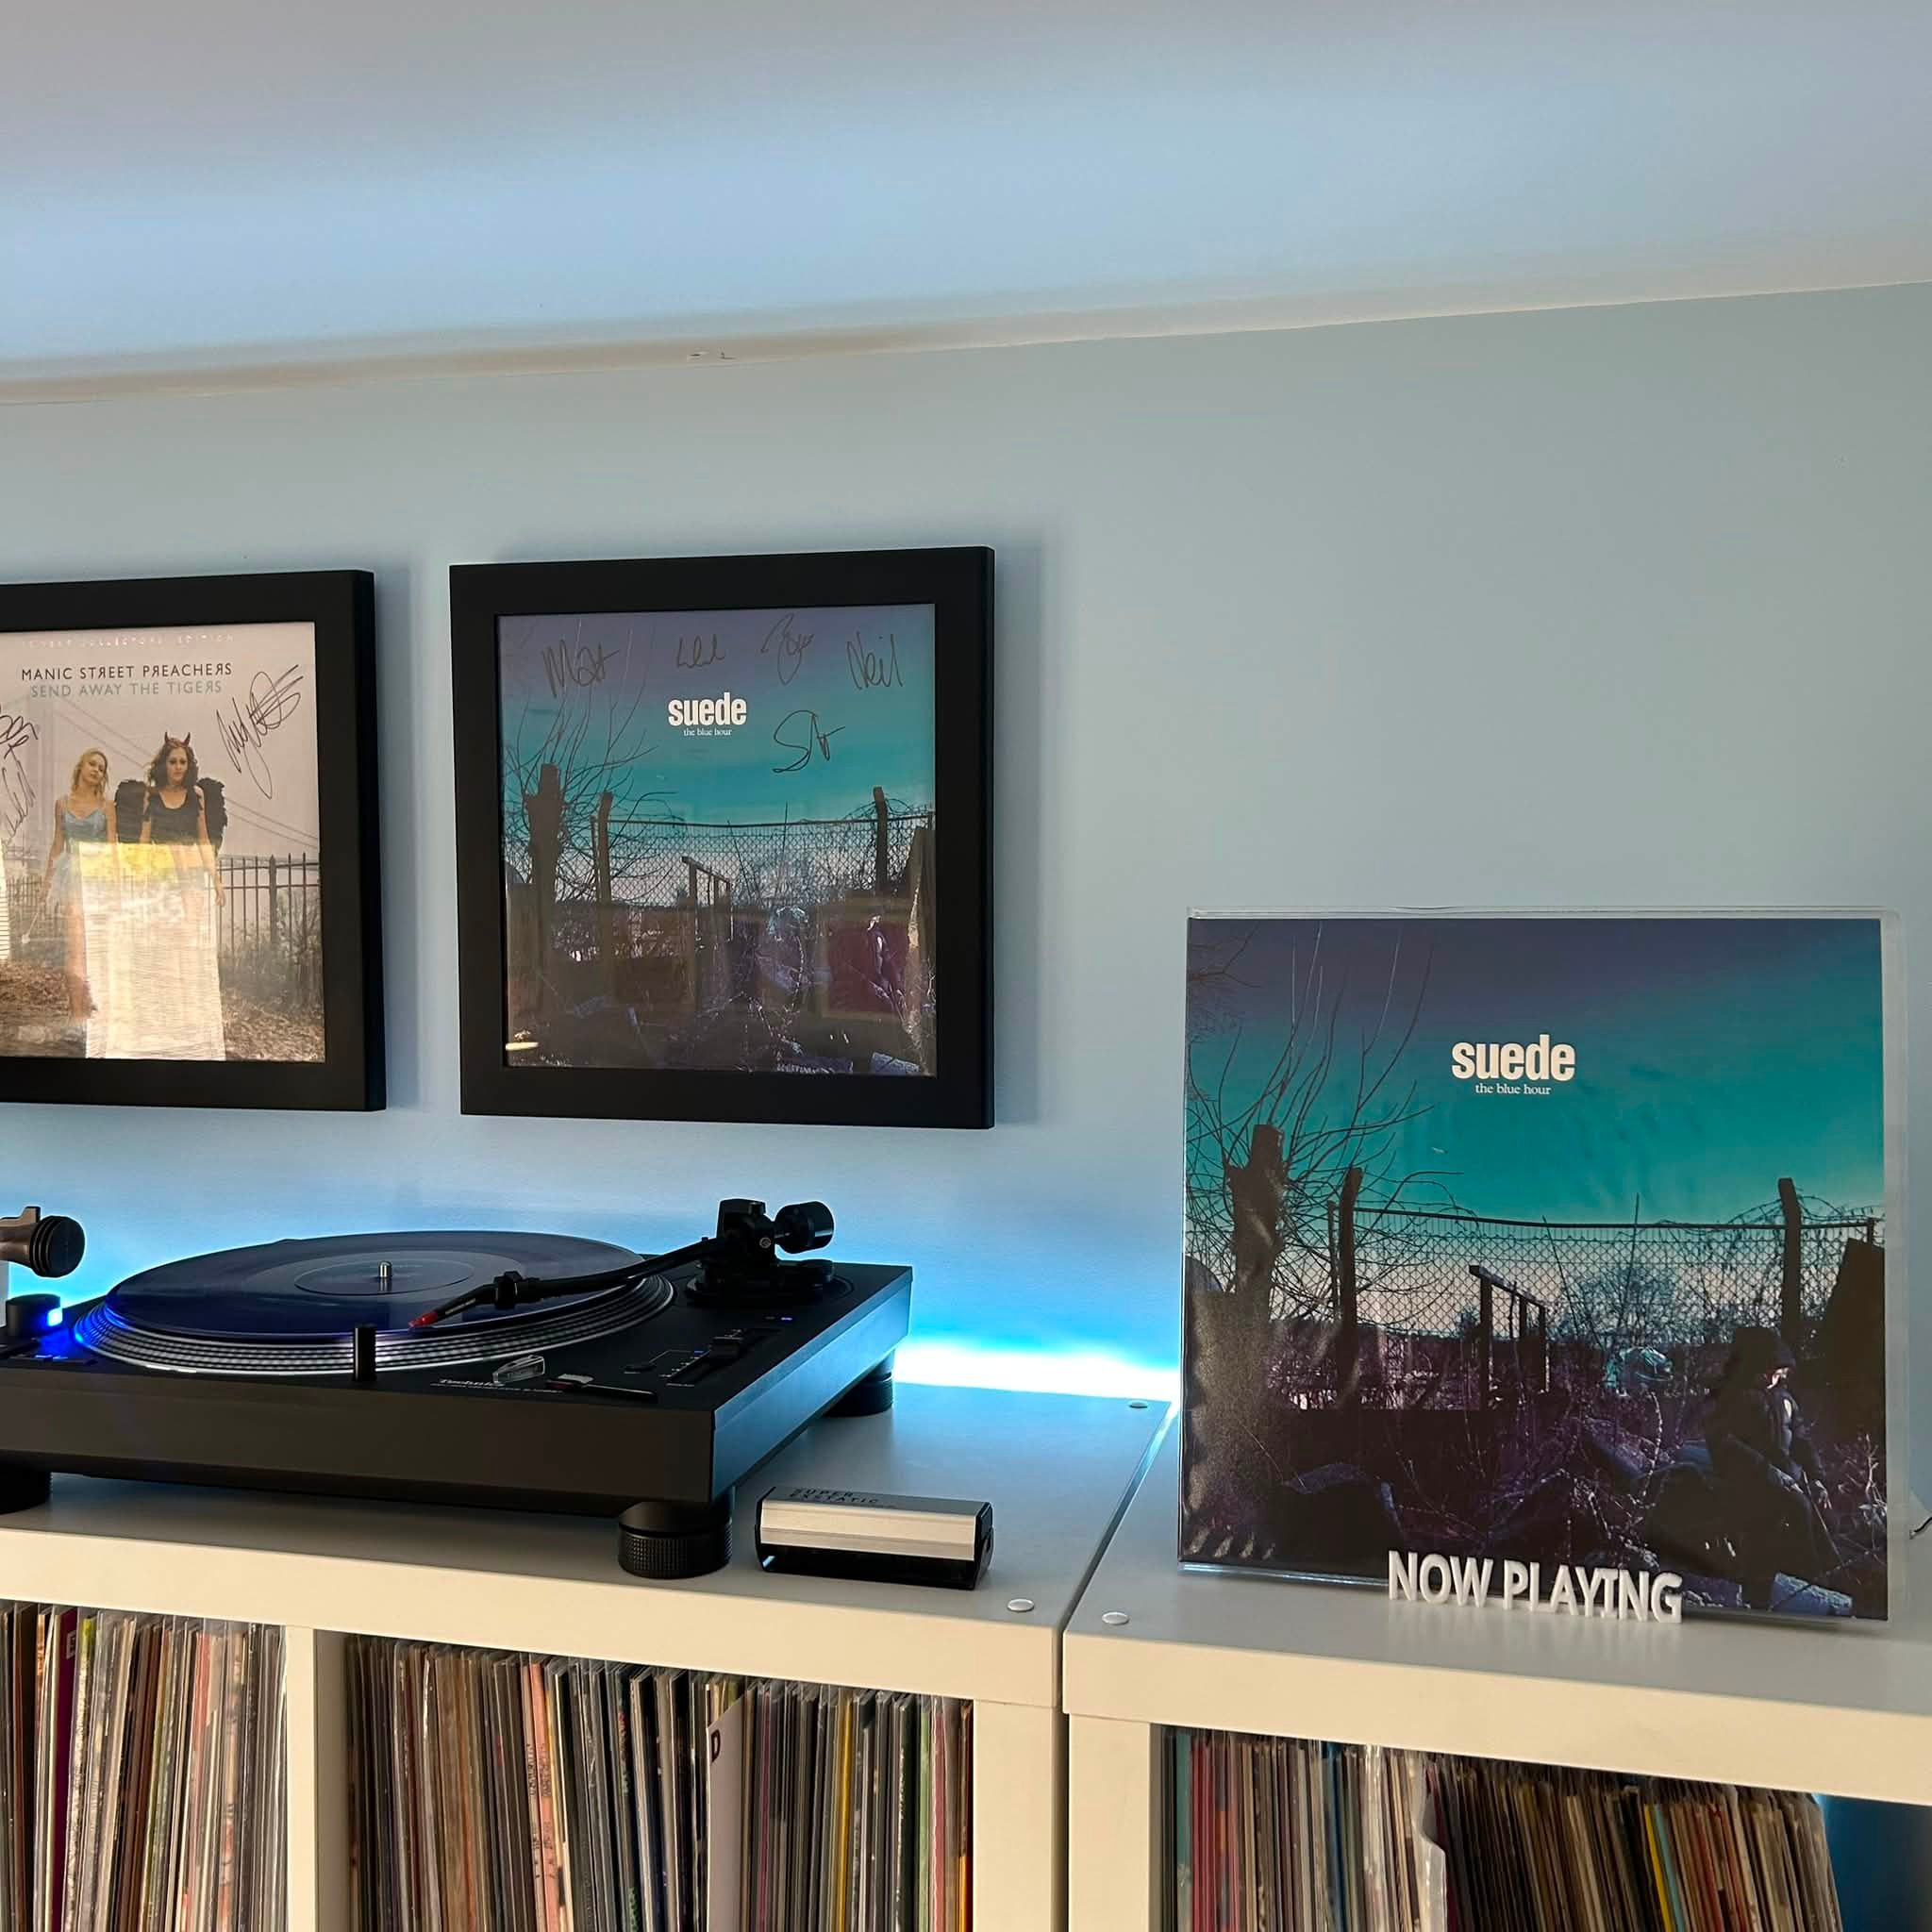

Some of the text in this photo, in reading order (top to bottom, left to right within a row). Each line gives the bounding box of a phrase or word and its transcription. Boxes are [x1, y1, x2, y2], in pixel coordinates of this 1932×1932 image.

[22, 667, 74, 681] MANIC
[31, 684, 72, 698] SEND
[79, 683, 122, 696] AWAY
[129, 682, 159, 695] THE
[668, 691, 747, 726] suede
[683, 727, 733, 737] the blue hour
[1451, 1033, 1576, 1082] suede
[1474, 1082, 1552, 1095] the blue hour
[1388, 1549, 1684, 1624] NOW PLAYING
